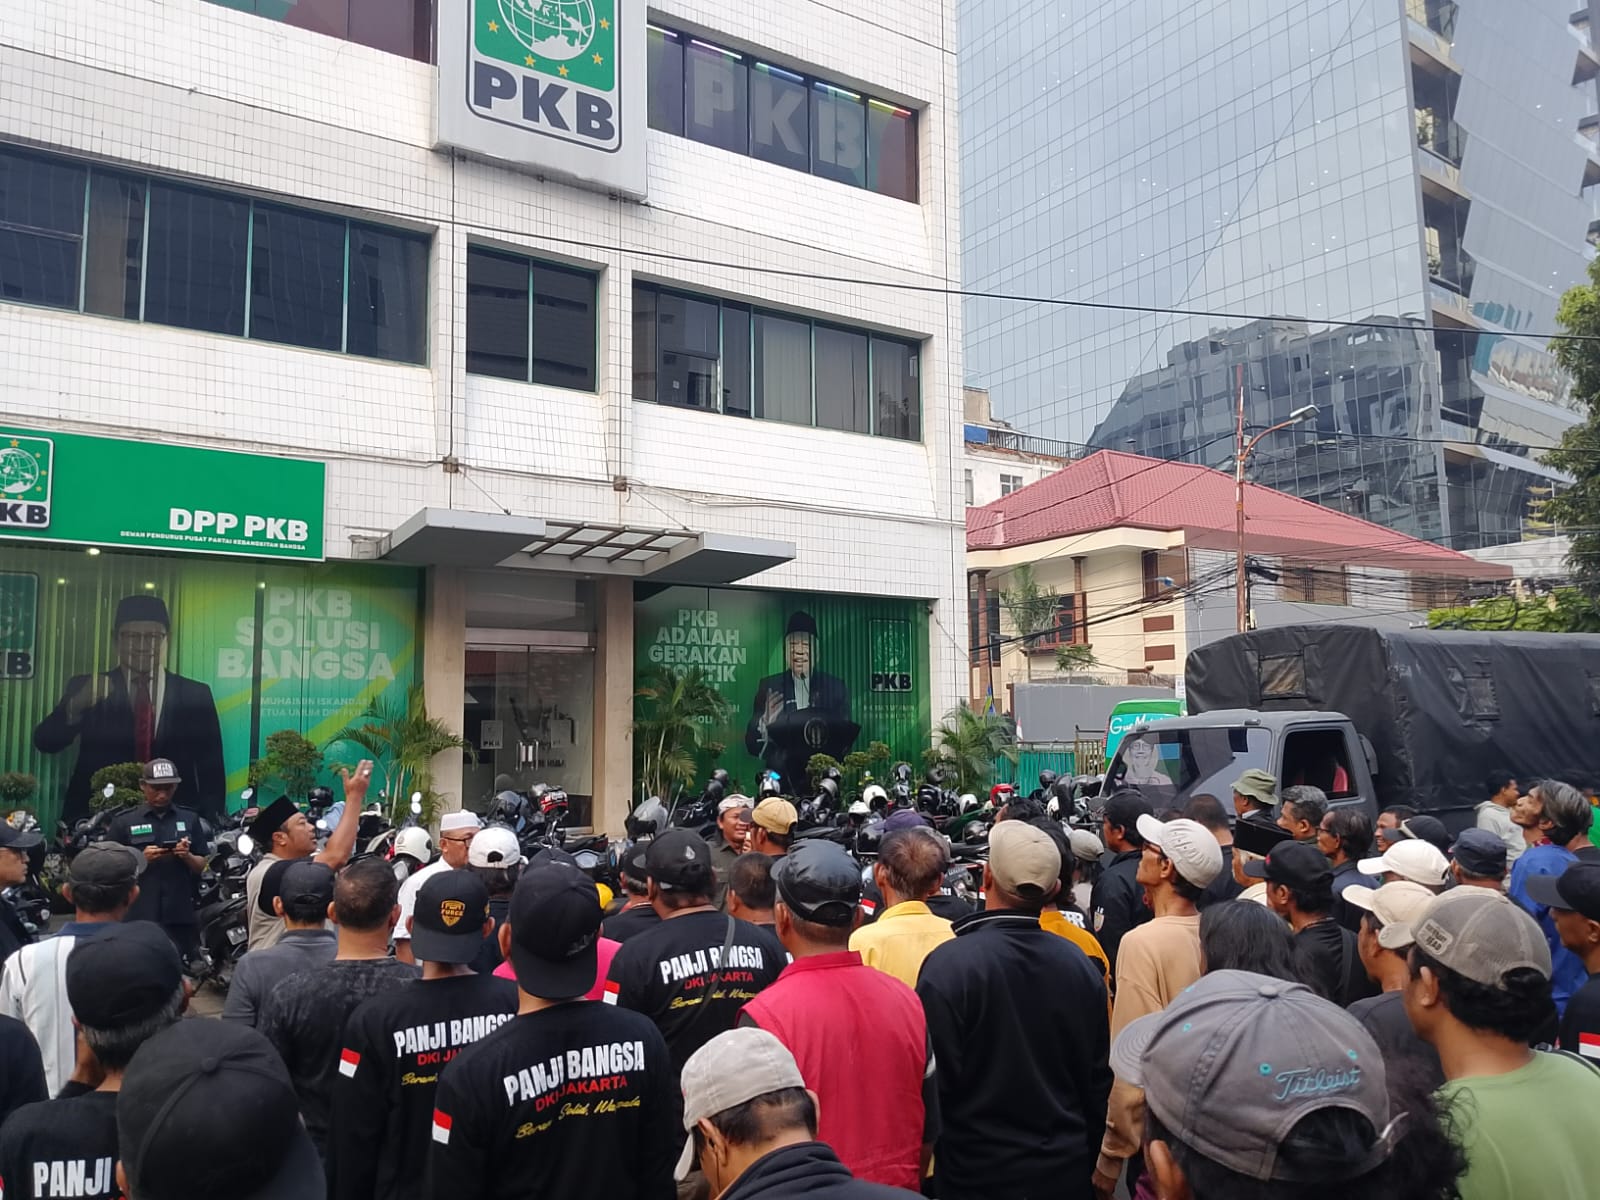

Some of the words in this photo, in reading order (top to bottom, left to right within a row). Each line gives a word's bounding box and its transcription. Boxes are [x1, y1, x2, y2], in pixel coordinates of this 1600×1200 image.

[473, 61, 615, 141] PKB
[694, 60, 861, 168] PKB
[0, 502, 48, 525] KB
[169, 507, 238, 534] DPP
[244, 515, 309, 541] PKB
[269, 587, 352, 617] PKB
[678, 609, 719, 627] PKB
[235, 616, 381, 649] SOLUSI
[655, 626, 740, 646] ADALAH
[217, 647, 395, 681] BANGSA
[648, 644, 747, 665] GERAKAN
[871, 673, 912, 690] PKB
[660, 950, 709, 985] PANJI
[684, 976, 705, 990] DKI
[393, 1022, 447, 1058] PANJI
[450, 1013, 515, 1046] BANG
[417, 1051, 440, 1067] DKI
[503, 1055, 565, 1107] PANJI
[566, 1041, 645, 1079] BANGSA
[534, 1090, 559, 1112] DKI
[559, 1075, 628, 1097] JAKARTA
[1274, 1066, 1361, 1100] Titleist
[33, 1156, 112, 1198] PANJI
